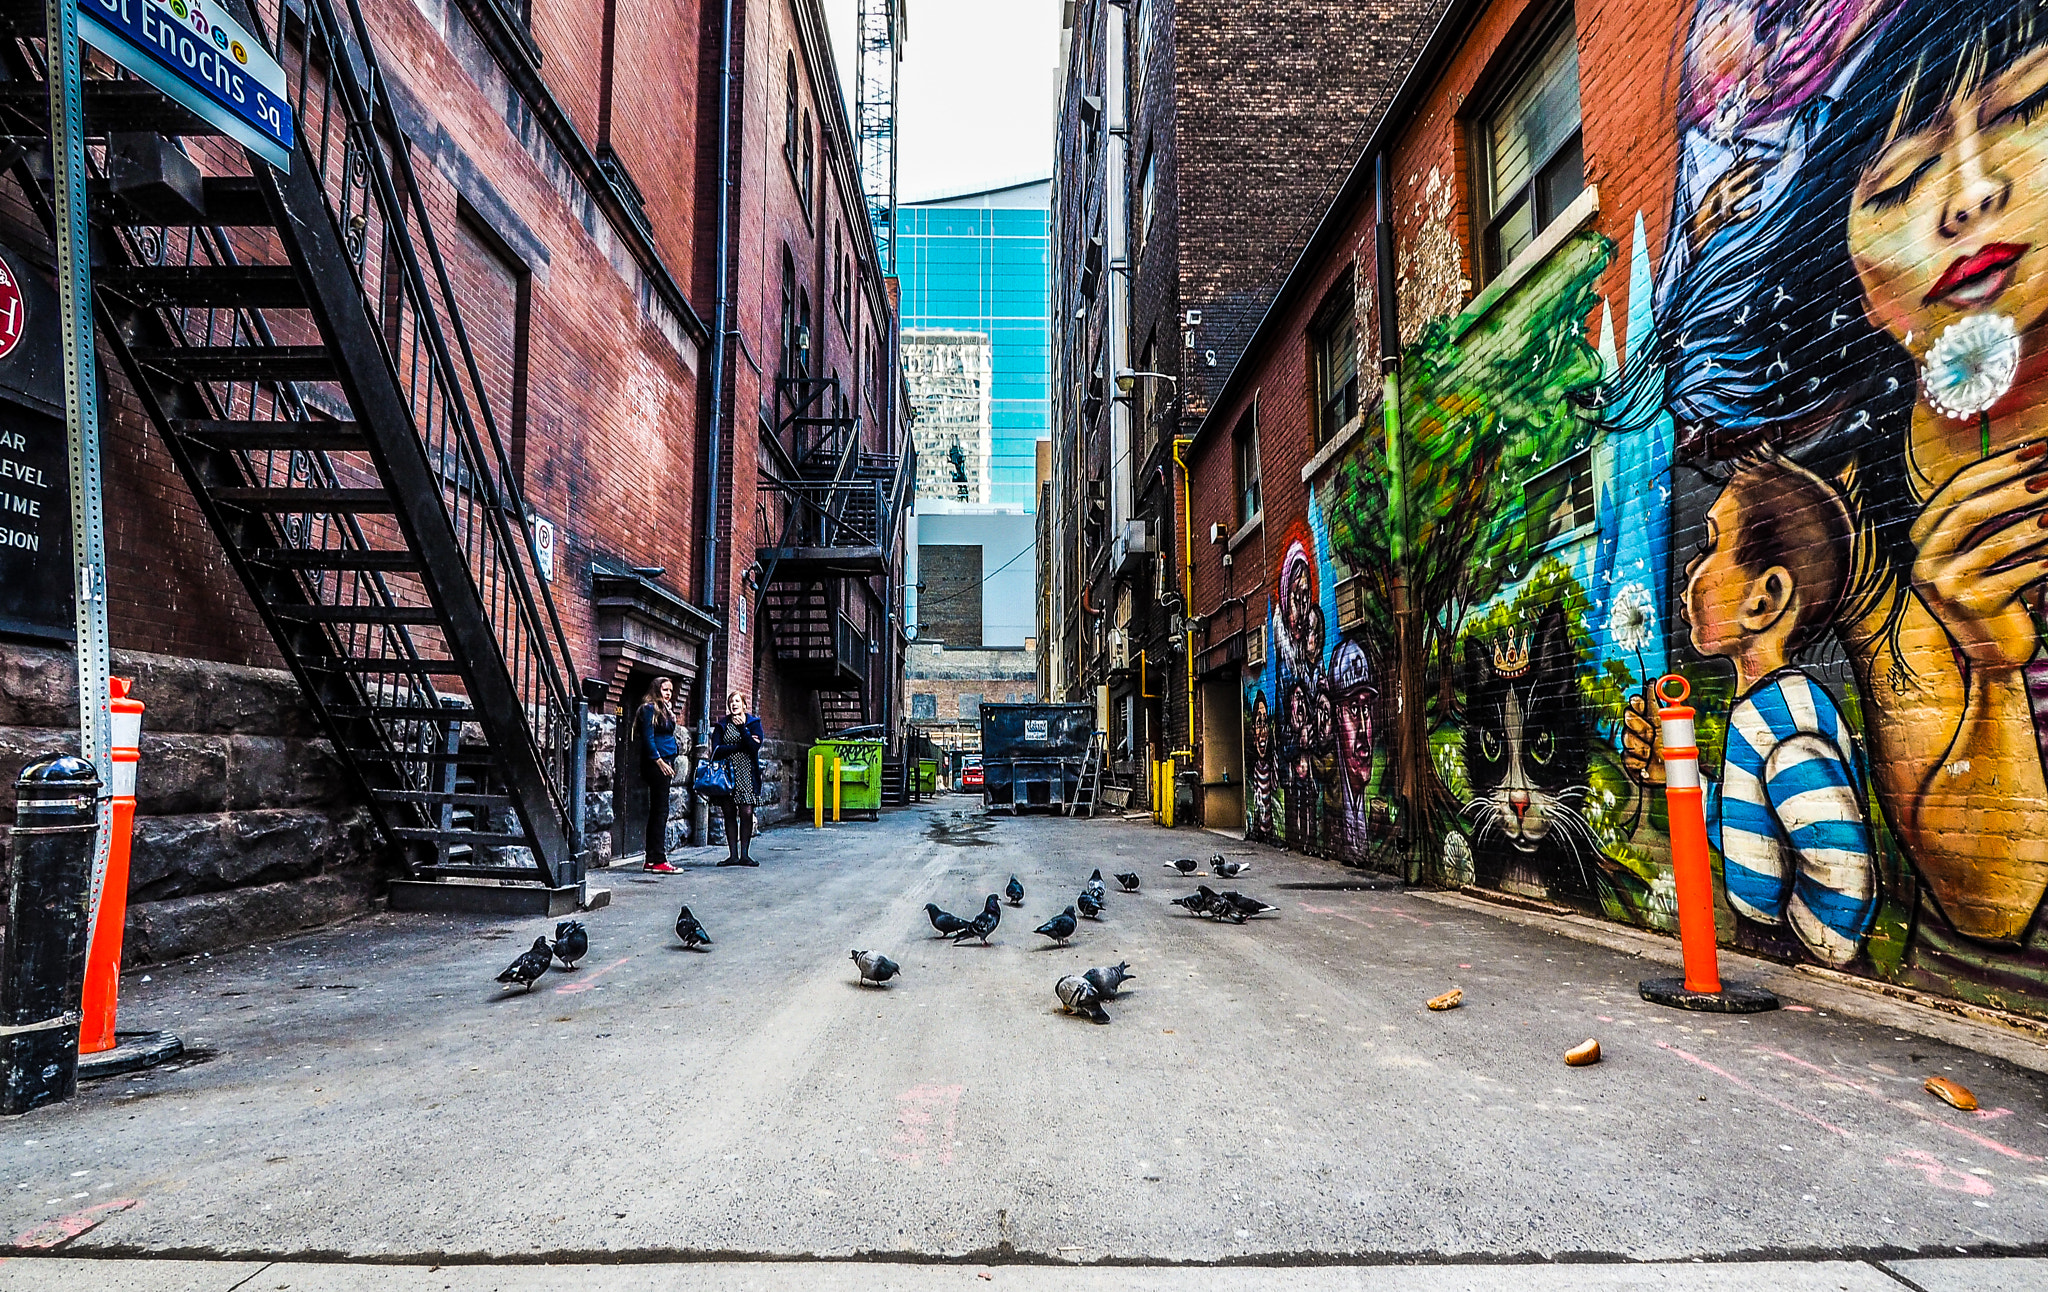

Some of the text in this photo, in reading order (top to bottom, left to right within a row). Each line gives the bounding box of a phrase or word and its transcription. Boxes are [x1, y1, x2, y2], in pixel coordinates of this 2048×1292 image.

[142, 0, 245, 103] Enochs
[257, 92, 281, 137] Sq
[0, 458, 48, 489] EVEL
